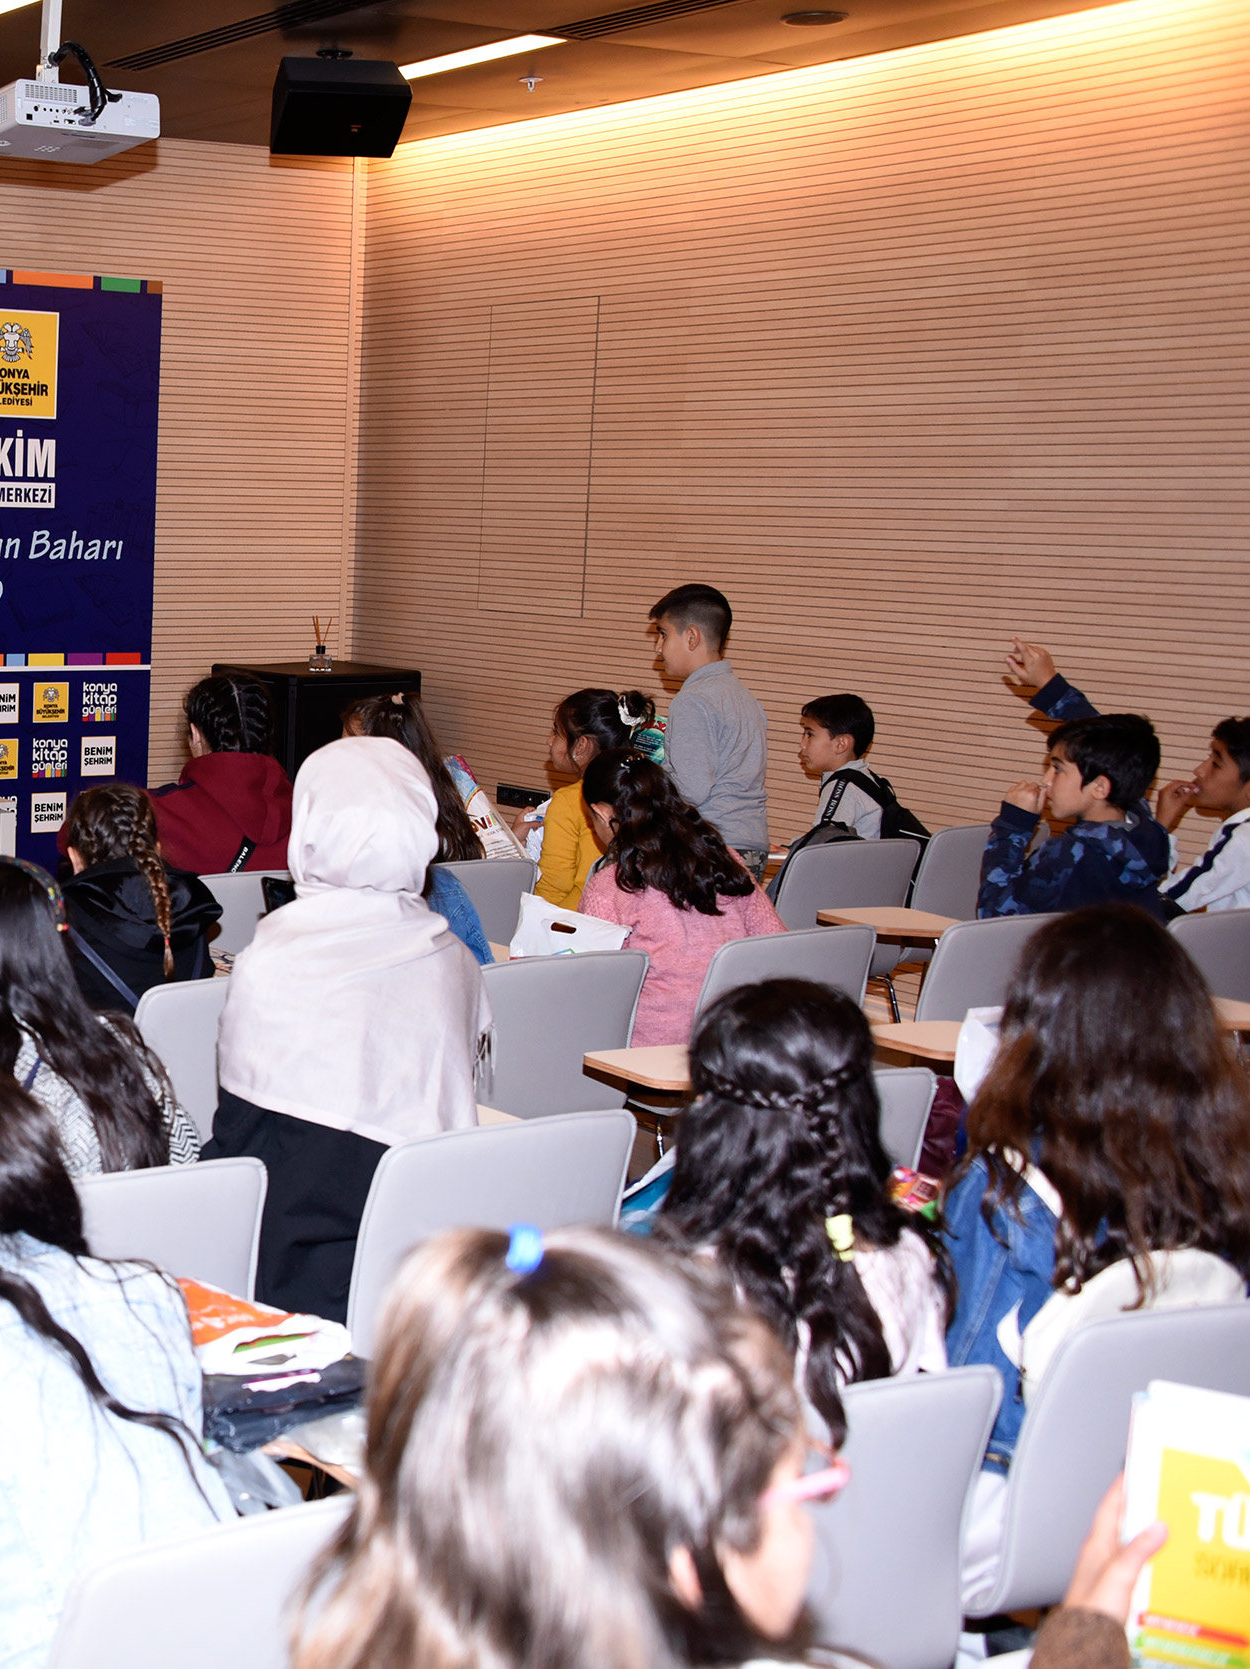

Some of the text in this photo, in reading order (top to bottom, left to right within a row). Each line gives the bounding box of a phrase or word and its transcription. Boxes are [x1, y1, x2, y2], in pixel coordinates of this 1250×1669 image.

[29, 530, 123, 560] Baharı
[83, 682, 117, 694] konya
[82, 692, 117, 706] kitap
[82, 705, 117, 717] günleri
[33, 738, 68, 750] konya
[32, 749, 68, 762] kitap
[32, 760, 67, 774] günleri
